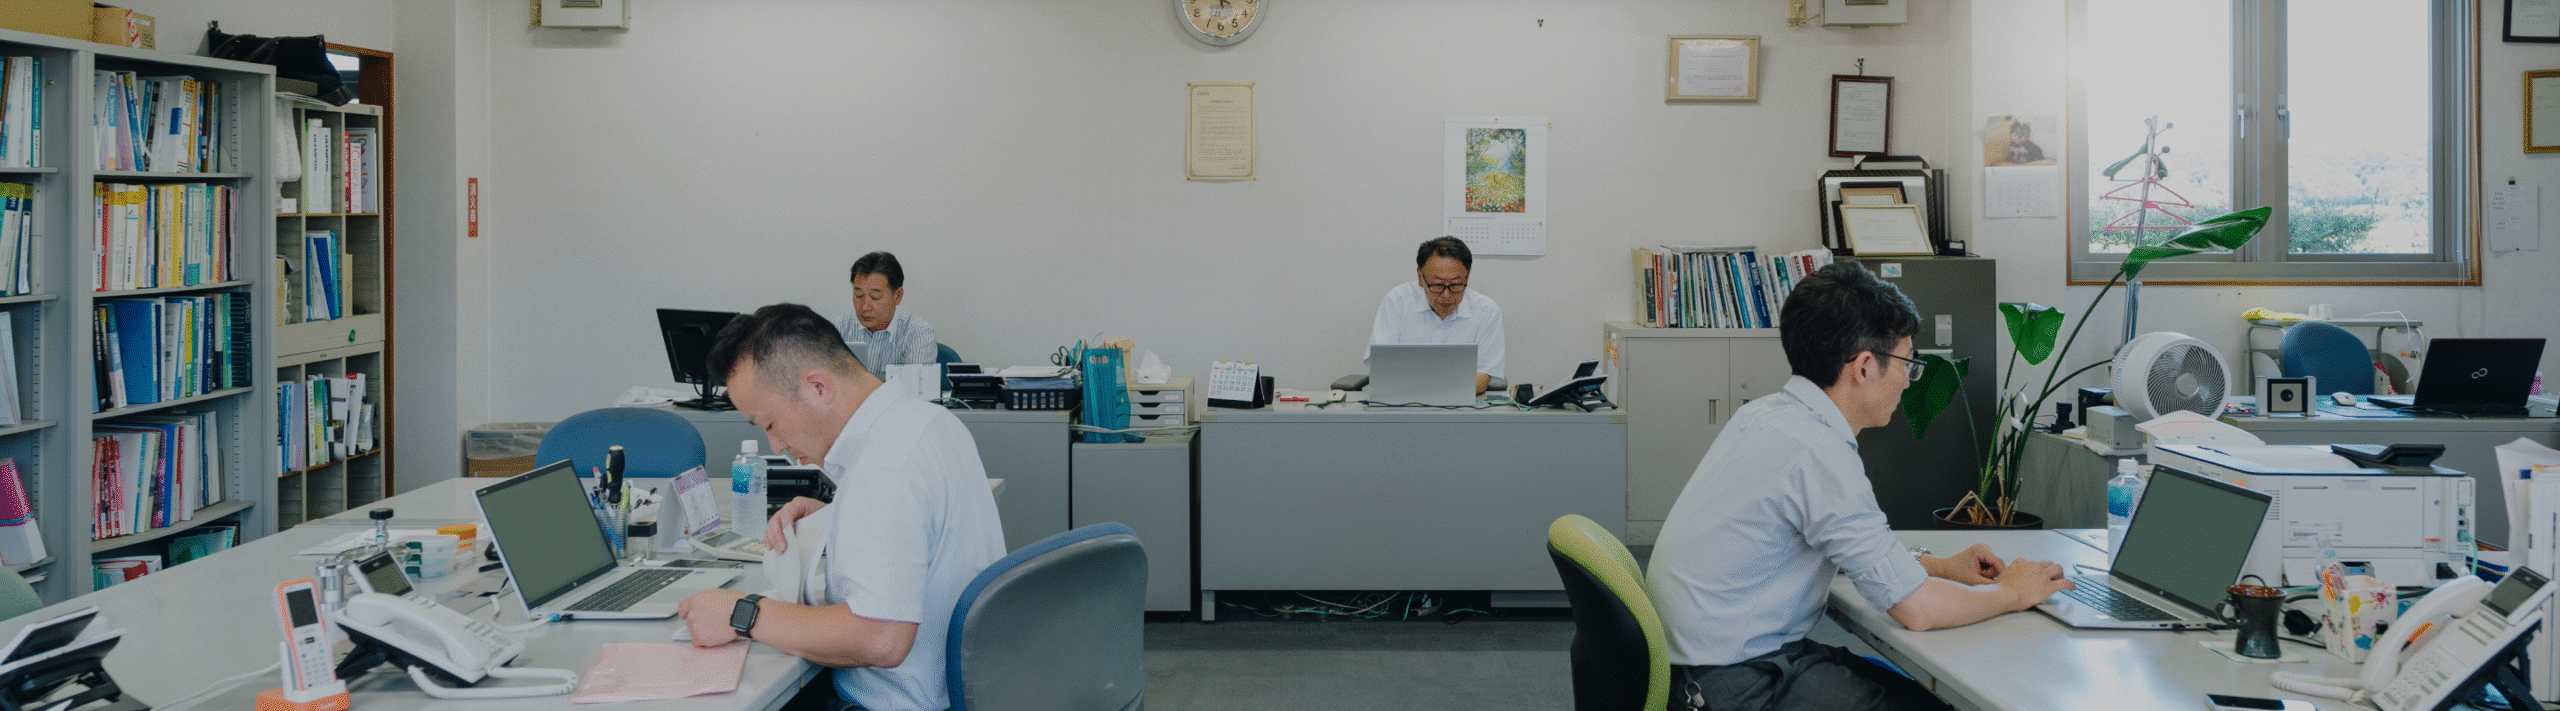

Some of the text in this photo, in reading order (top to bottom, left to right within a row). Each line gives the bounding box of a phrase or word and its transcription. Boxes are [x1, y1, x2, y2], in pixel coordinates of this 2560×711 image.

[1194, 8, 1200, 18] 8
[1241, 9, 1248, 17] 4
[1206, 18, 1212, 28] 7
[1217, 23, 1225, 31] 6
[1232, 18, 1238, 28] 5
[469, 182, 477, 223] 消火器
